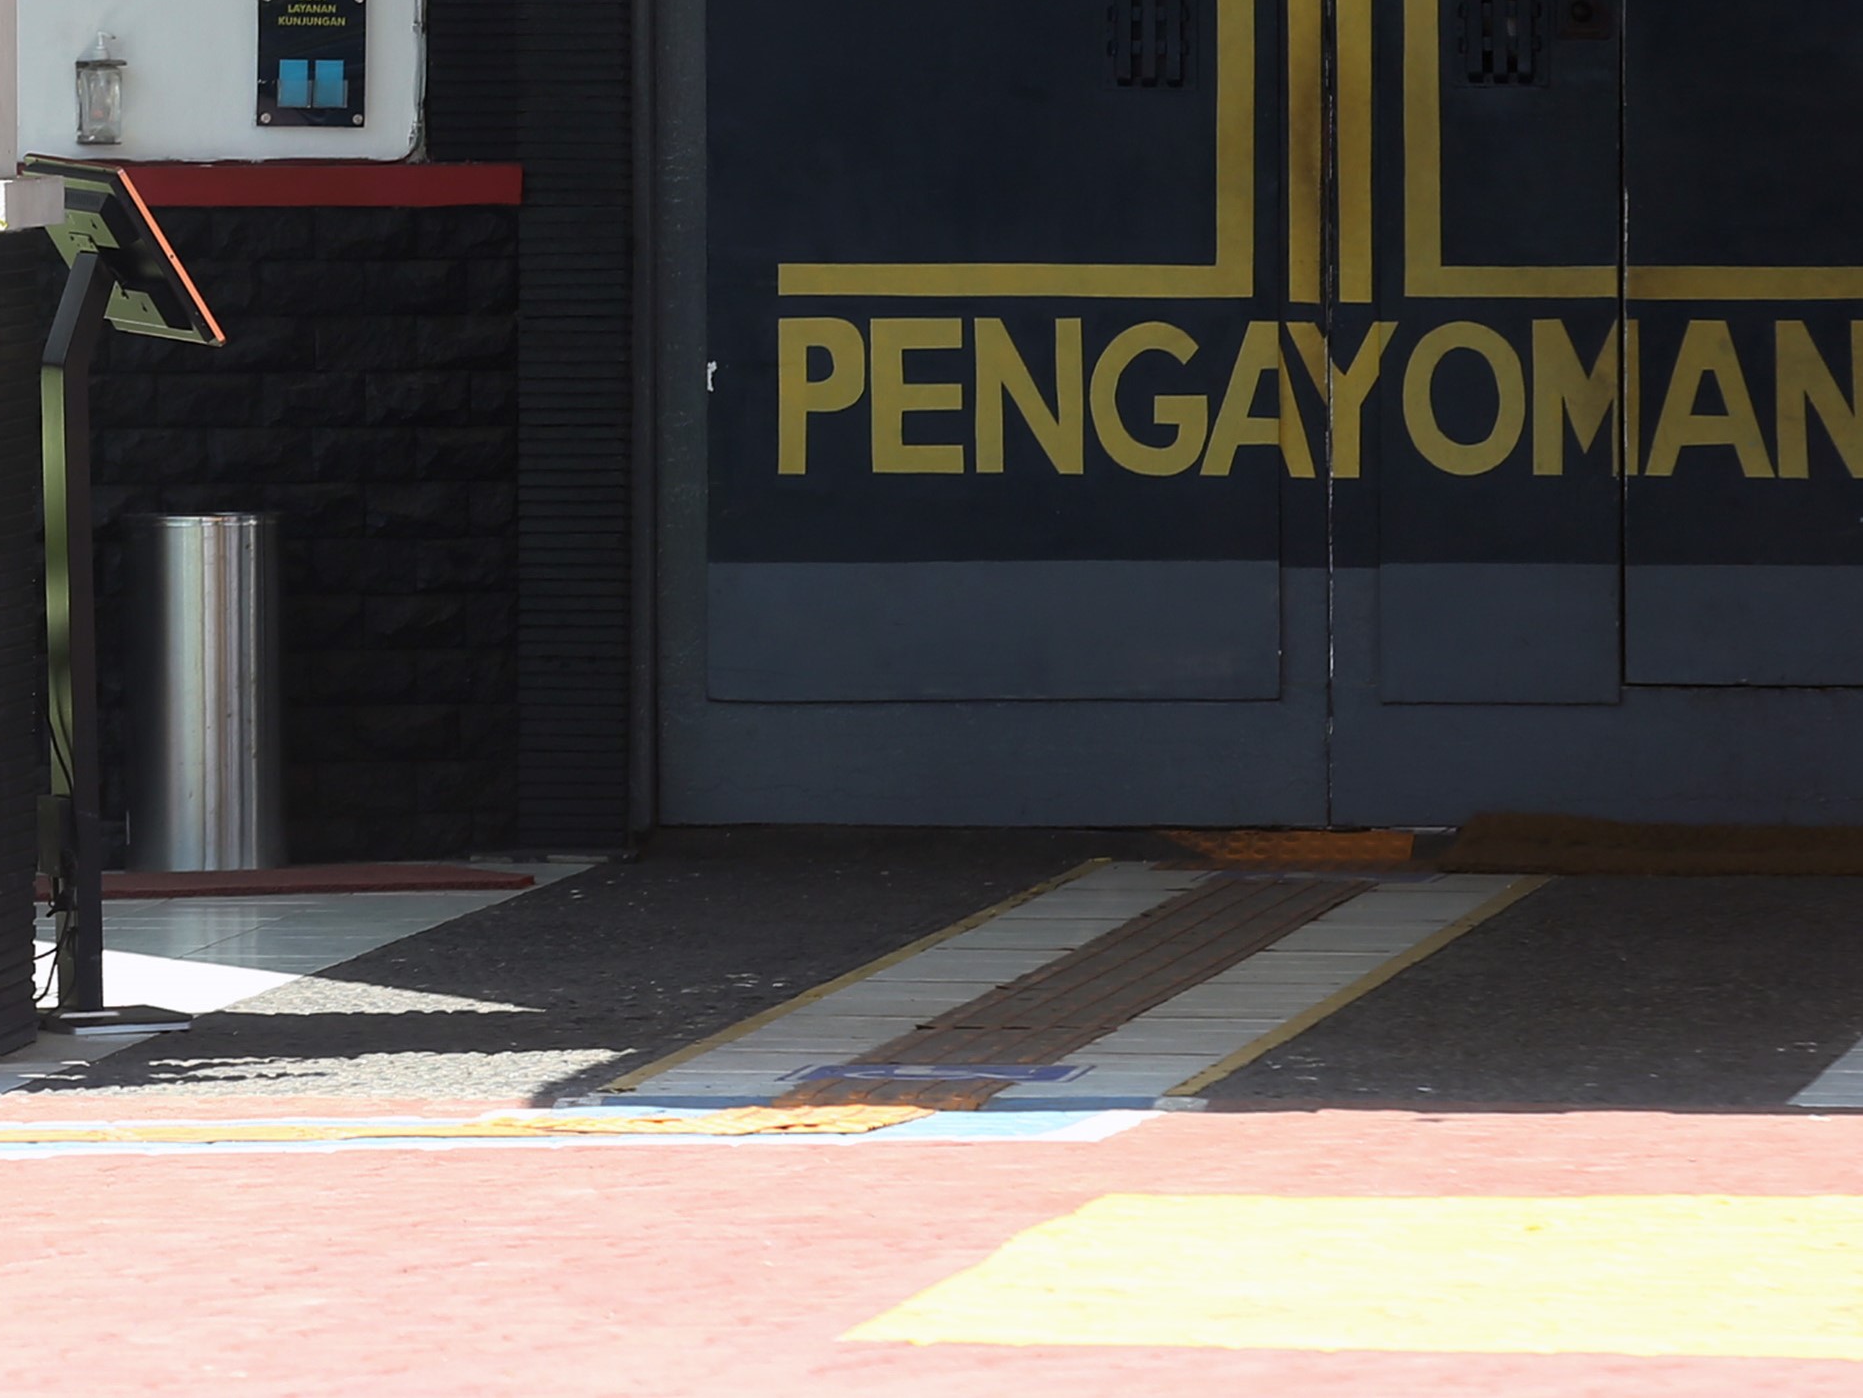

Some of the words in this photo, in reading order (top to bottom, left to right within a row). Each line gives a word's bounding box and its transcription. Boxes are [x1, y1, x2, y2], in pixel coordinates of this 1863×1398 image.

[287, 4, 336, 14] LAYANAN
[278, 16, 346, 26] KUNJUNGAN
[778, 316, 1863, 480] PENGAYOMAN
